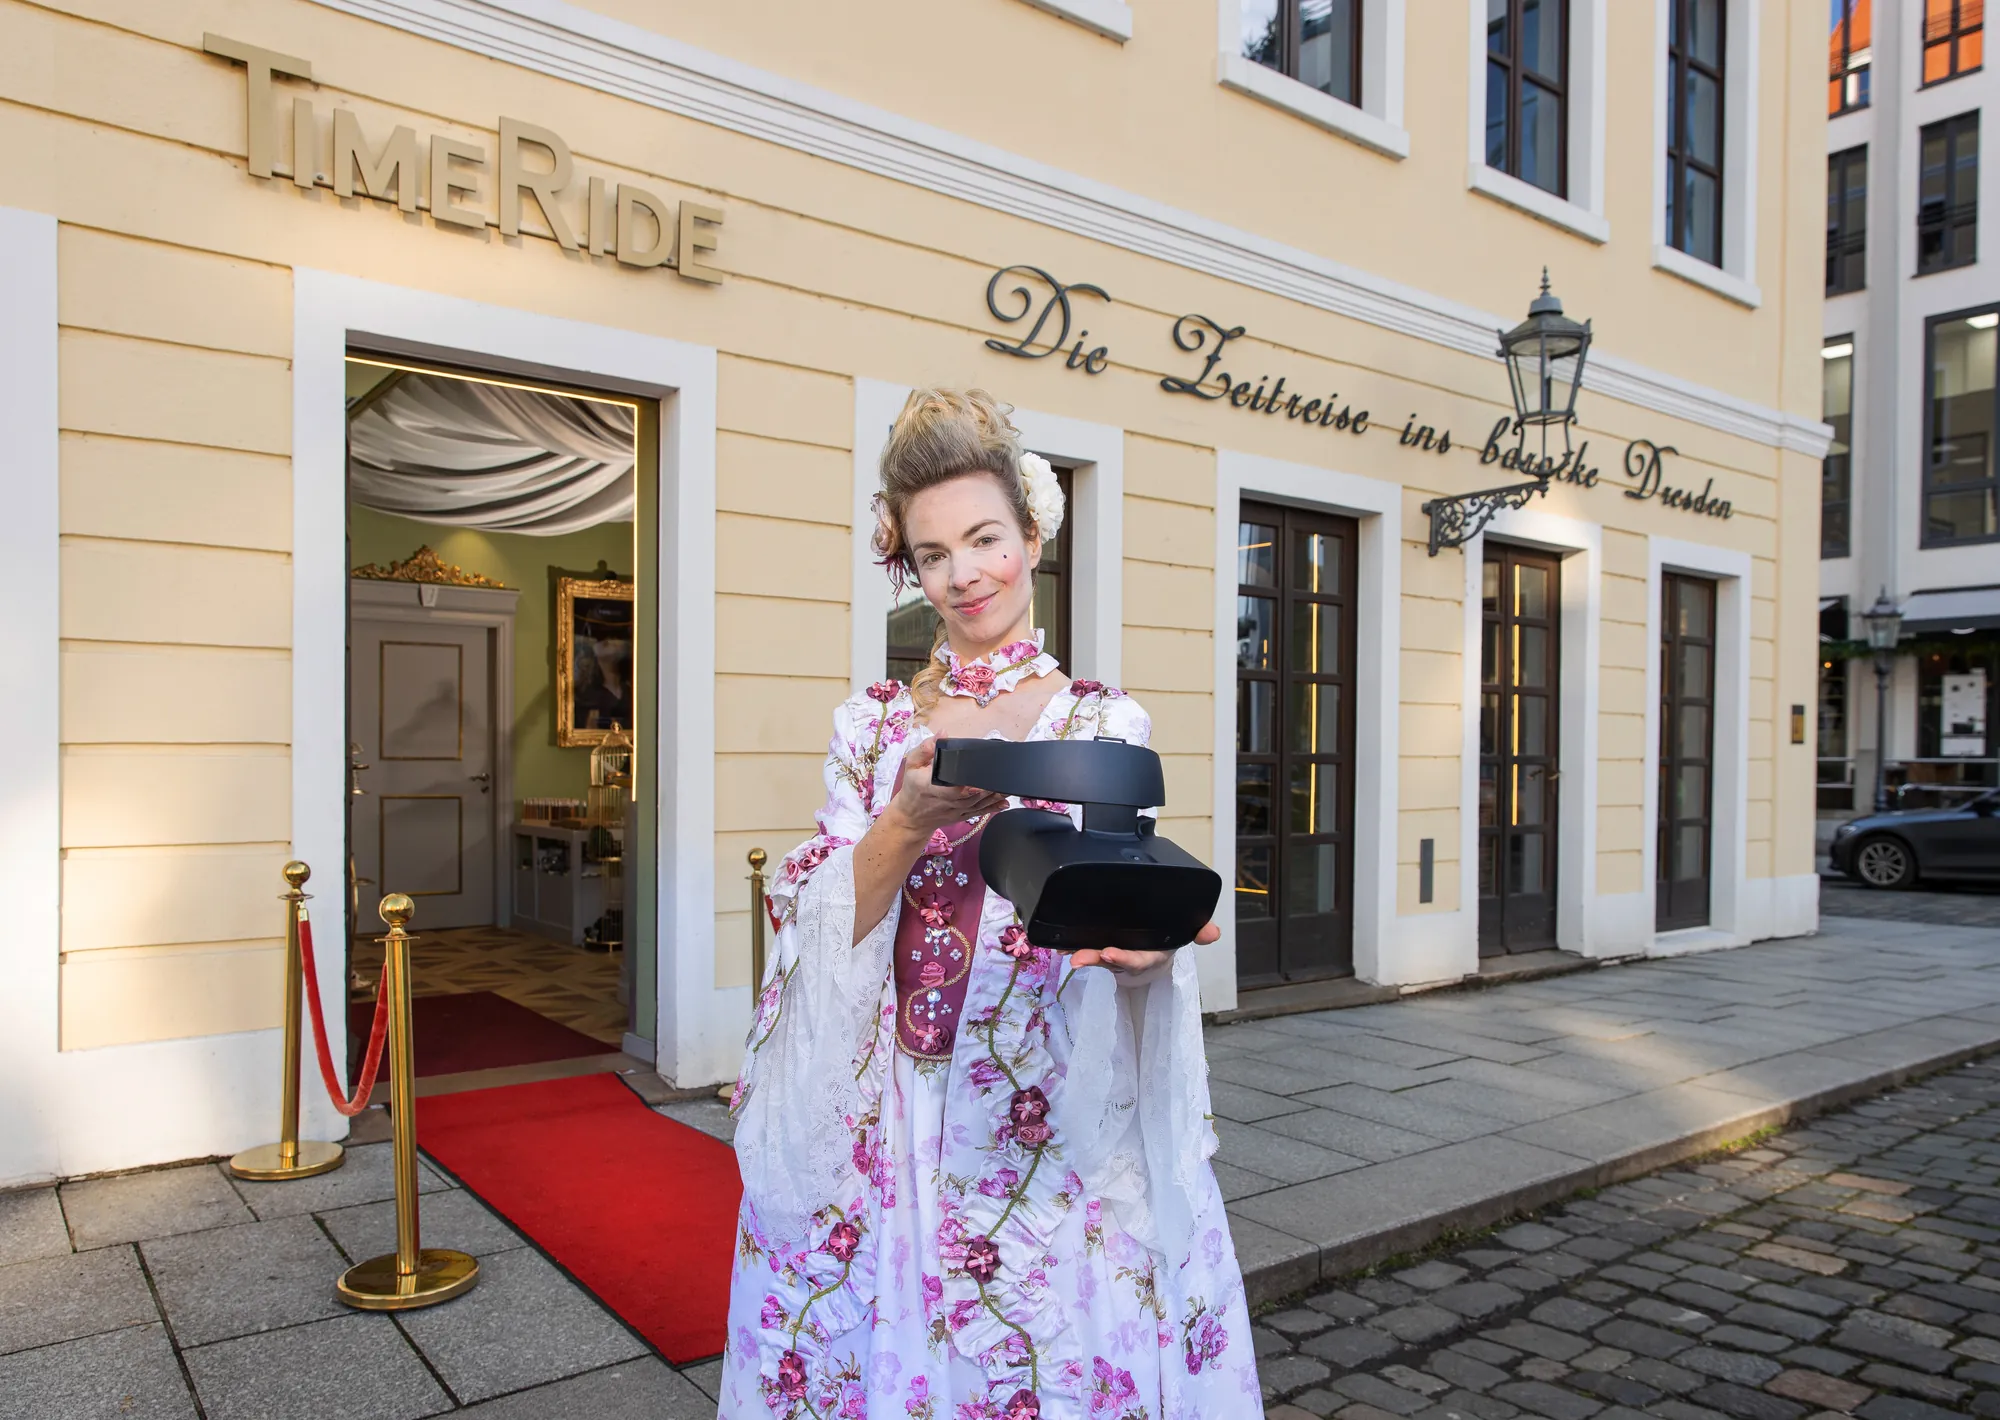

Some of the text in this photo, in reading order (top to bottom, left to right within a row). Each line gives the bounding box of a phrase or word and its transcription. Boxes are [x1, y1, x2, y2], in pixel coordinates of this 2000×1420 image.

[985, 265, 1111, 375] Die
[1160, 313, 1371, 435] Zeitreise
[1400, 413, 1452, 454] ins
[1623, 439, 1734, 520] Dresden
